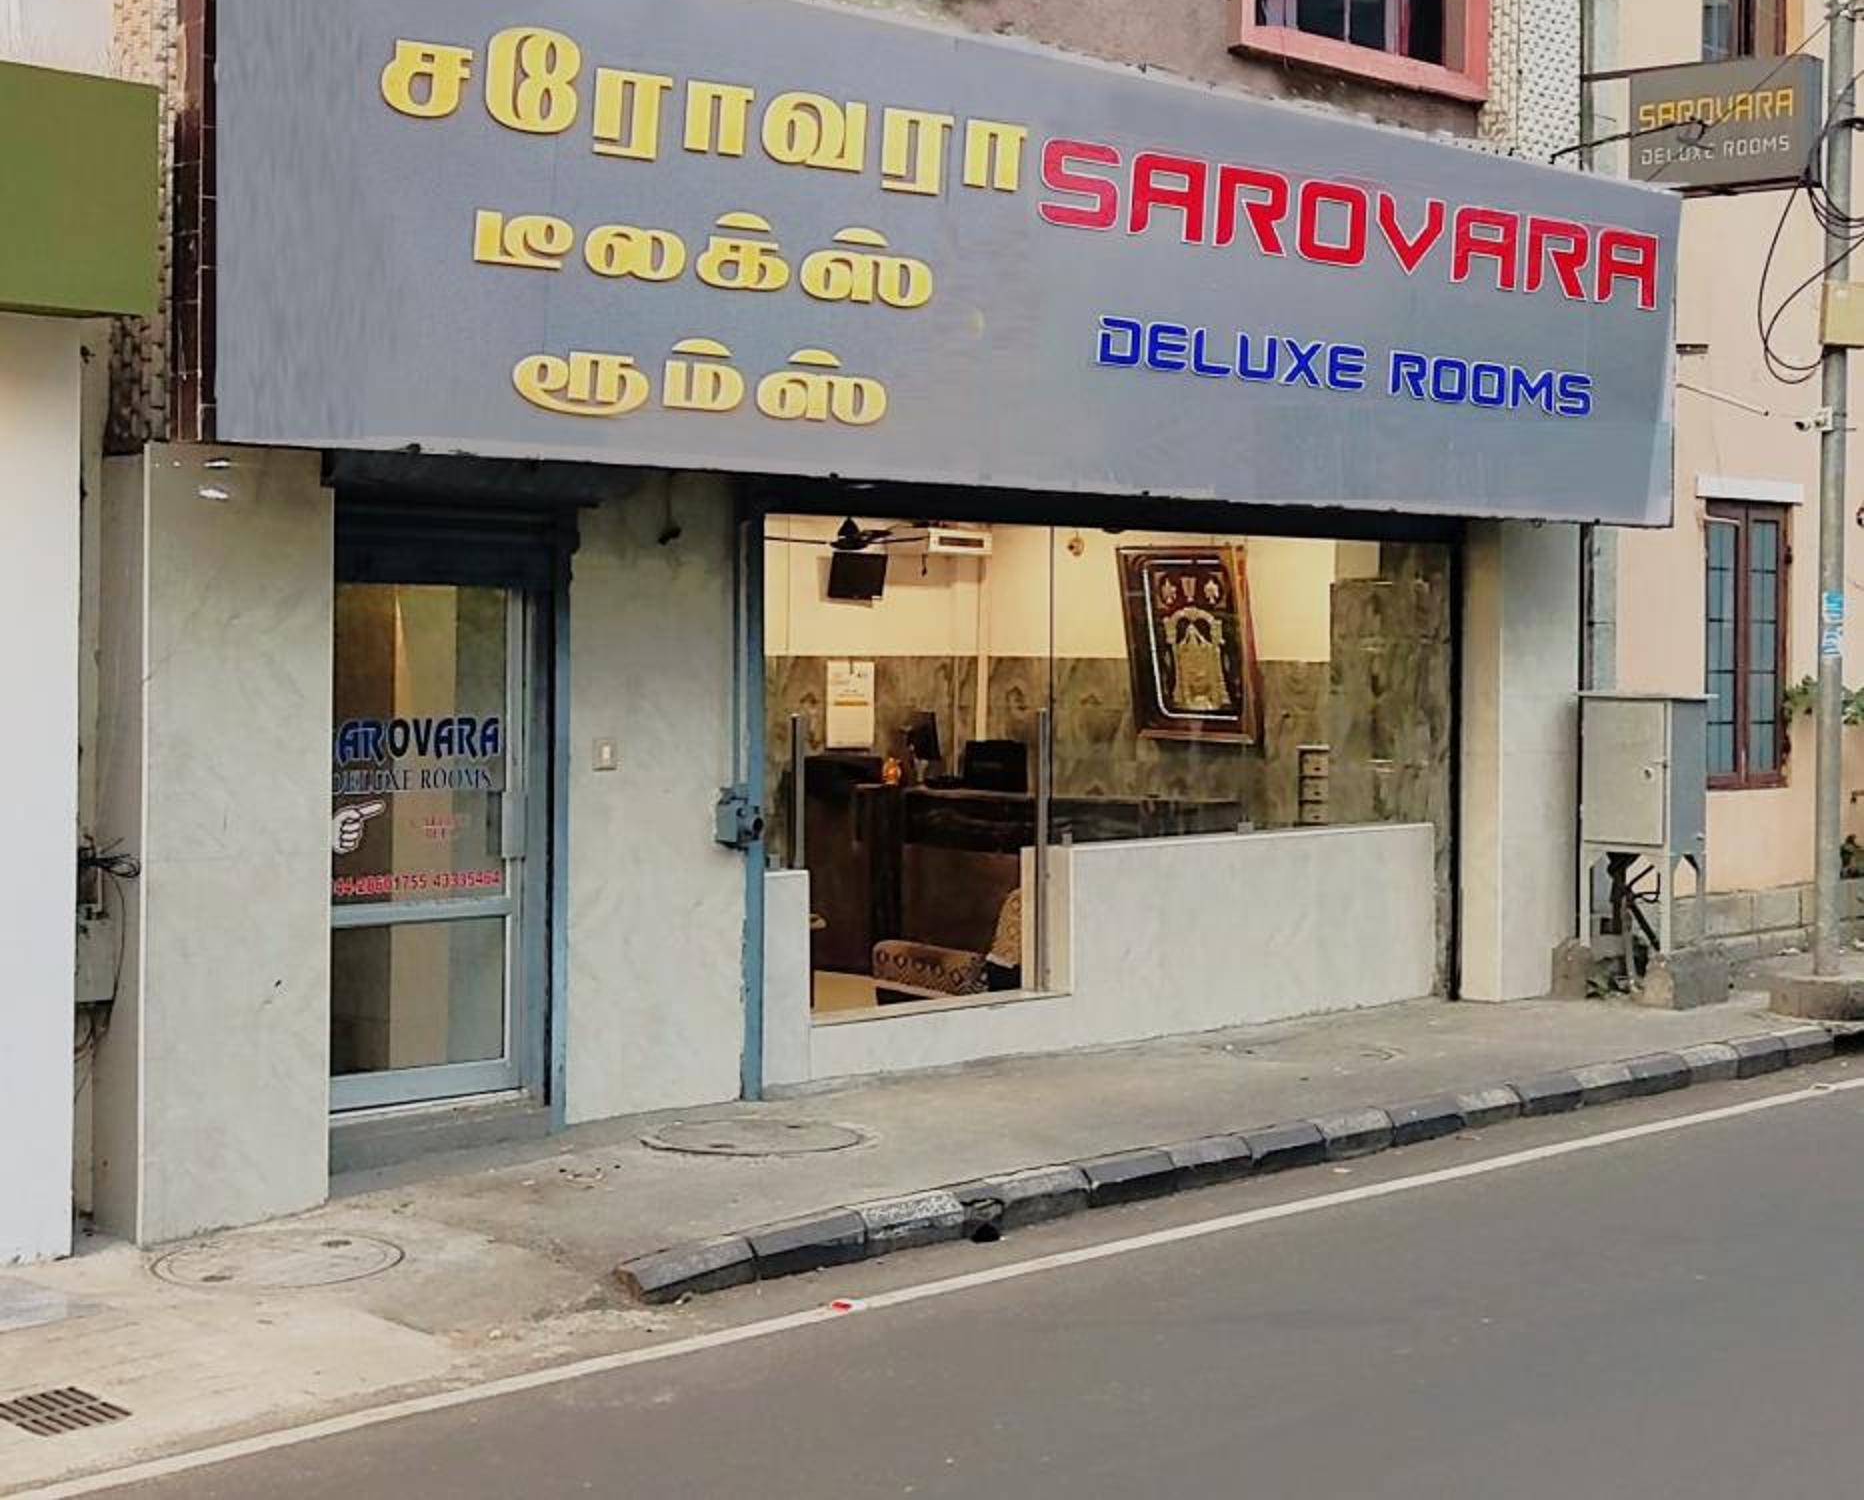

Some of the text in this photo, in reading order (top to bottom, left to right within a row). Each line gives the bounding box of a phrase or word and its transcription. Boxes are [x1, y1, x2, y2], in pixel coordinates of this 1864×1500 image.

[381, 26, 1028, 195] சரோவரா
[1638, 88, 1794, 131] SAROVARA
[1723, 135, 1790, 158] ROOMS
[473, 211, 934, 309] டீலக்ஸ்
[1039, 138, 1660, 310] SAROVARA
[512, 338, 888, 426] ரூம்ஸ்
[1097, 315, 1593, 418] DELUXE ROOMS
[334, 717, 500, 763] AROVARA
[421, 769, 494, 790] ROOMS
